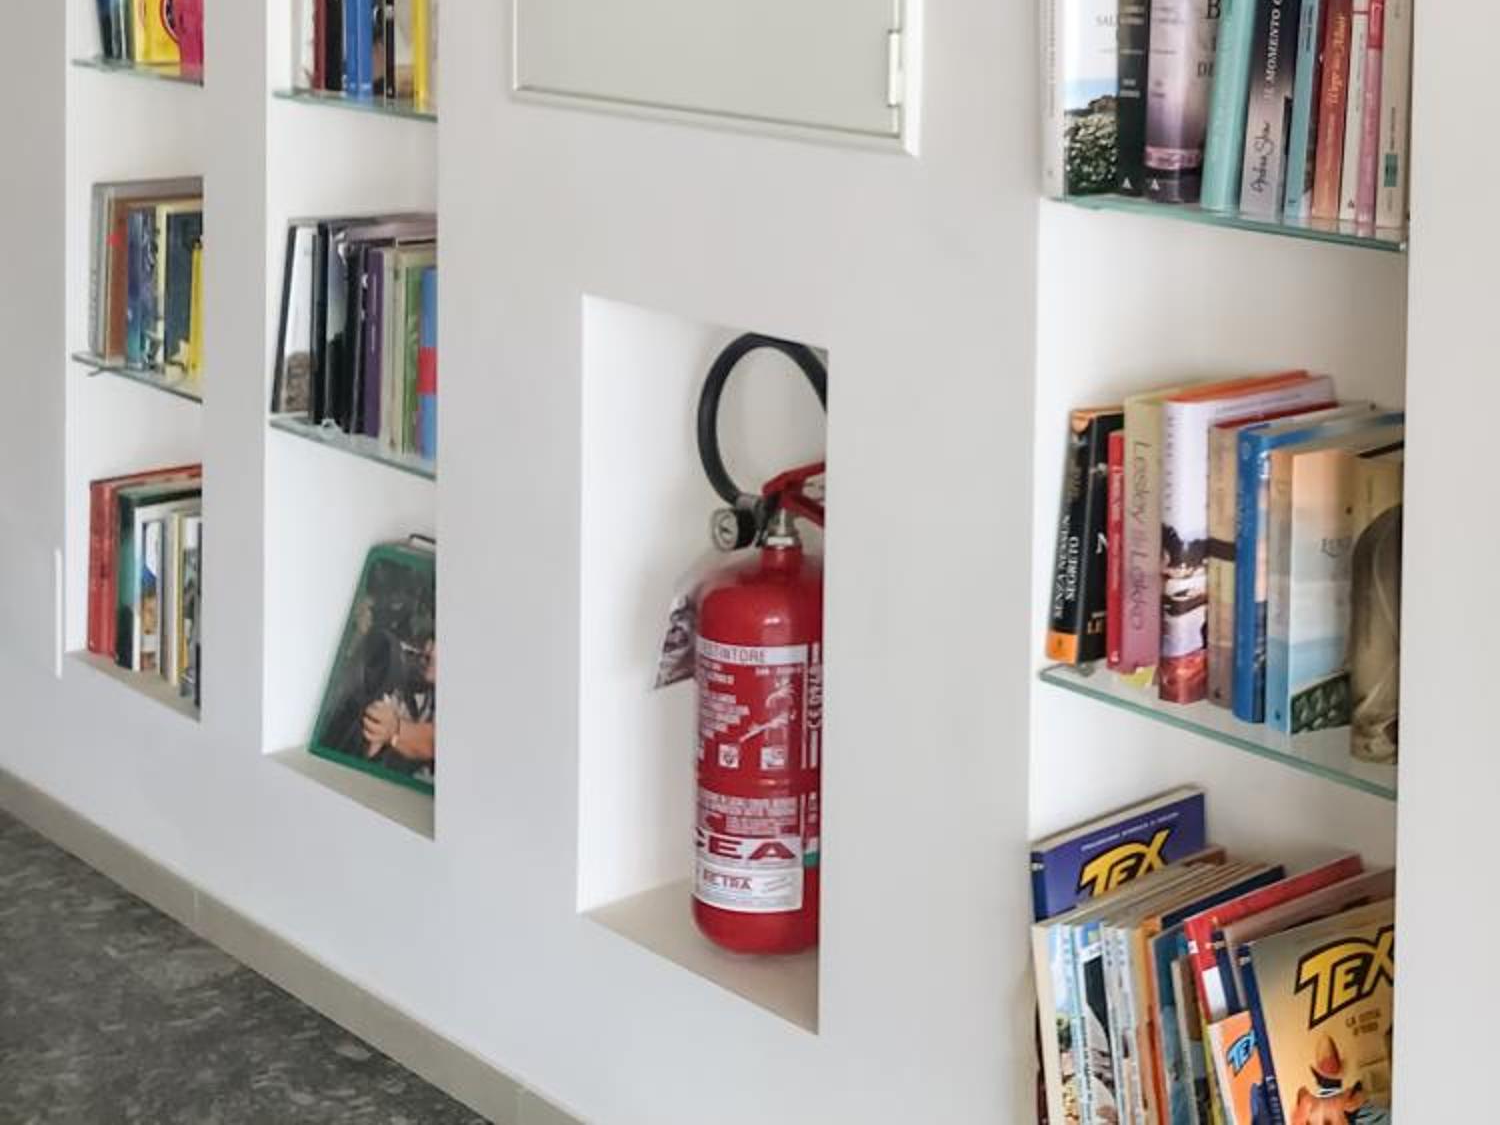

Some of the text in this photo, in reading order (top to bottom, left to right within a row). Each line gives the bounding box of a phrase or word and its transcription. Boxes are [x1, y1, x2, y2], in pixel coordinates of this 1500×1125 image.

[1264, 8, 1281, 83] MOMENTO
[1065, 535, 1080, 602] SEGRETO
[1076, 826, 1172, 897] TEX
[1226, 1030, 1257, 1077] TE
